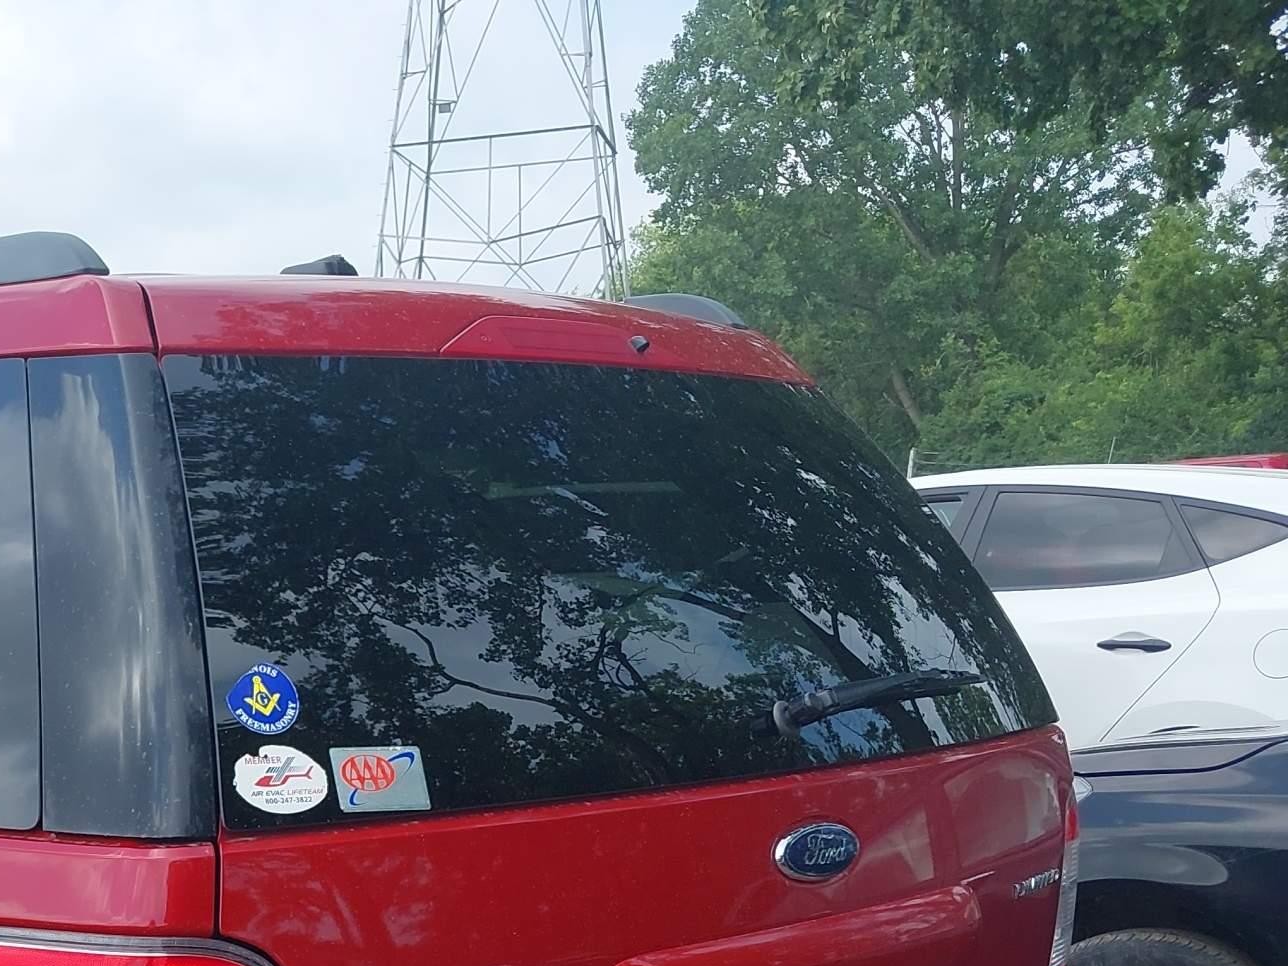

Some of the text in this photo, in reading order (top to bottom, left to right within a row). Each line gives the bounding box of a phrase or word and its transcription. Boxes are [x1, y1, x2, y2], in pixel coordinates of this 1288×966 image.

[257, 692, 269, 706] G
[234, 700, 297, 732] FREEMASONRY
[244, 755, 283, 765] MEMBER
[342, 754, 395, 791] AAA
[804, 830, 847, 865] Ford
